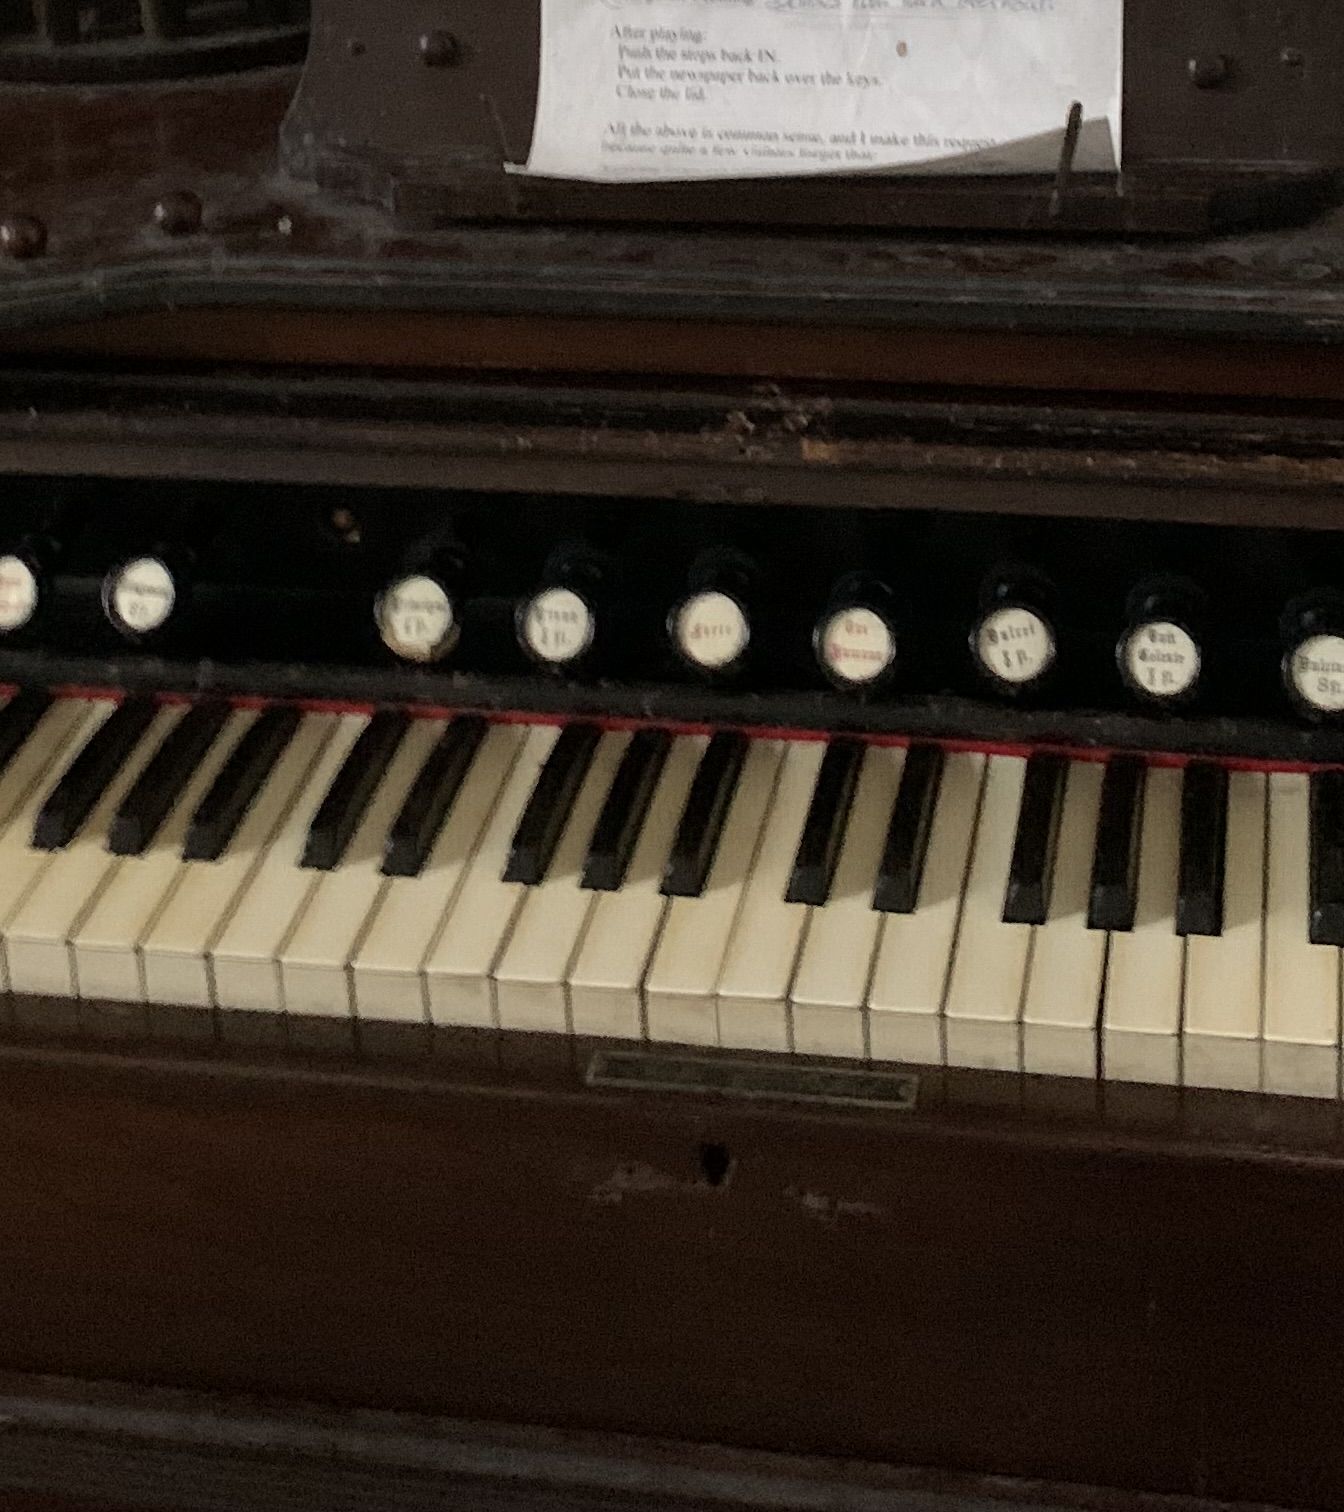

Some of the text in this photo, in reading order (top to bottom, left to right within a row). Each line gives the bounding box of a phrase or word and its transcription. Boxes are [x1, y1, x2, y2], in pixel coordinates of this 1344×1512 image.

[609, 24, 646, 42] After
[617, 44, 652, 61] Push
[655, 45, 677, 62] the
[720, 46, 753, 64] back
[617, 64, 641, 80] Put
[644, 65, 666, 81] the
[669, 68, 744, 86] newspaper
[748, 68, 780, 84] back
[784, 71, 816, 86] over
[820, 69, 843, 86] the
[615, 84, 656, 102] Close
[659, 86, 680, 102] the
[630, 122, 652, 138] the
[829, 130, 856, 145] and
[913, 132, 940, 148] this
